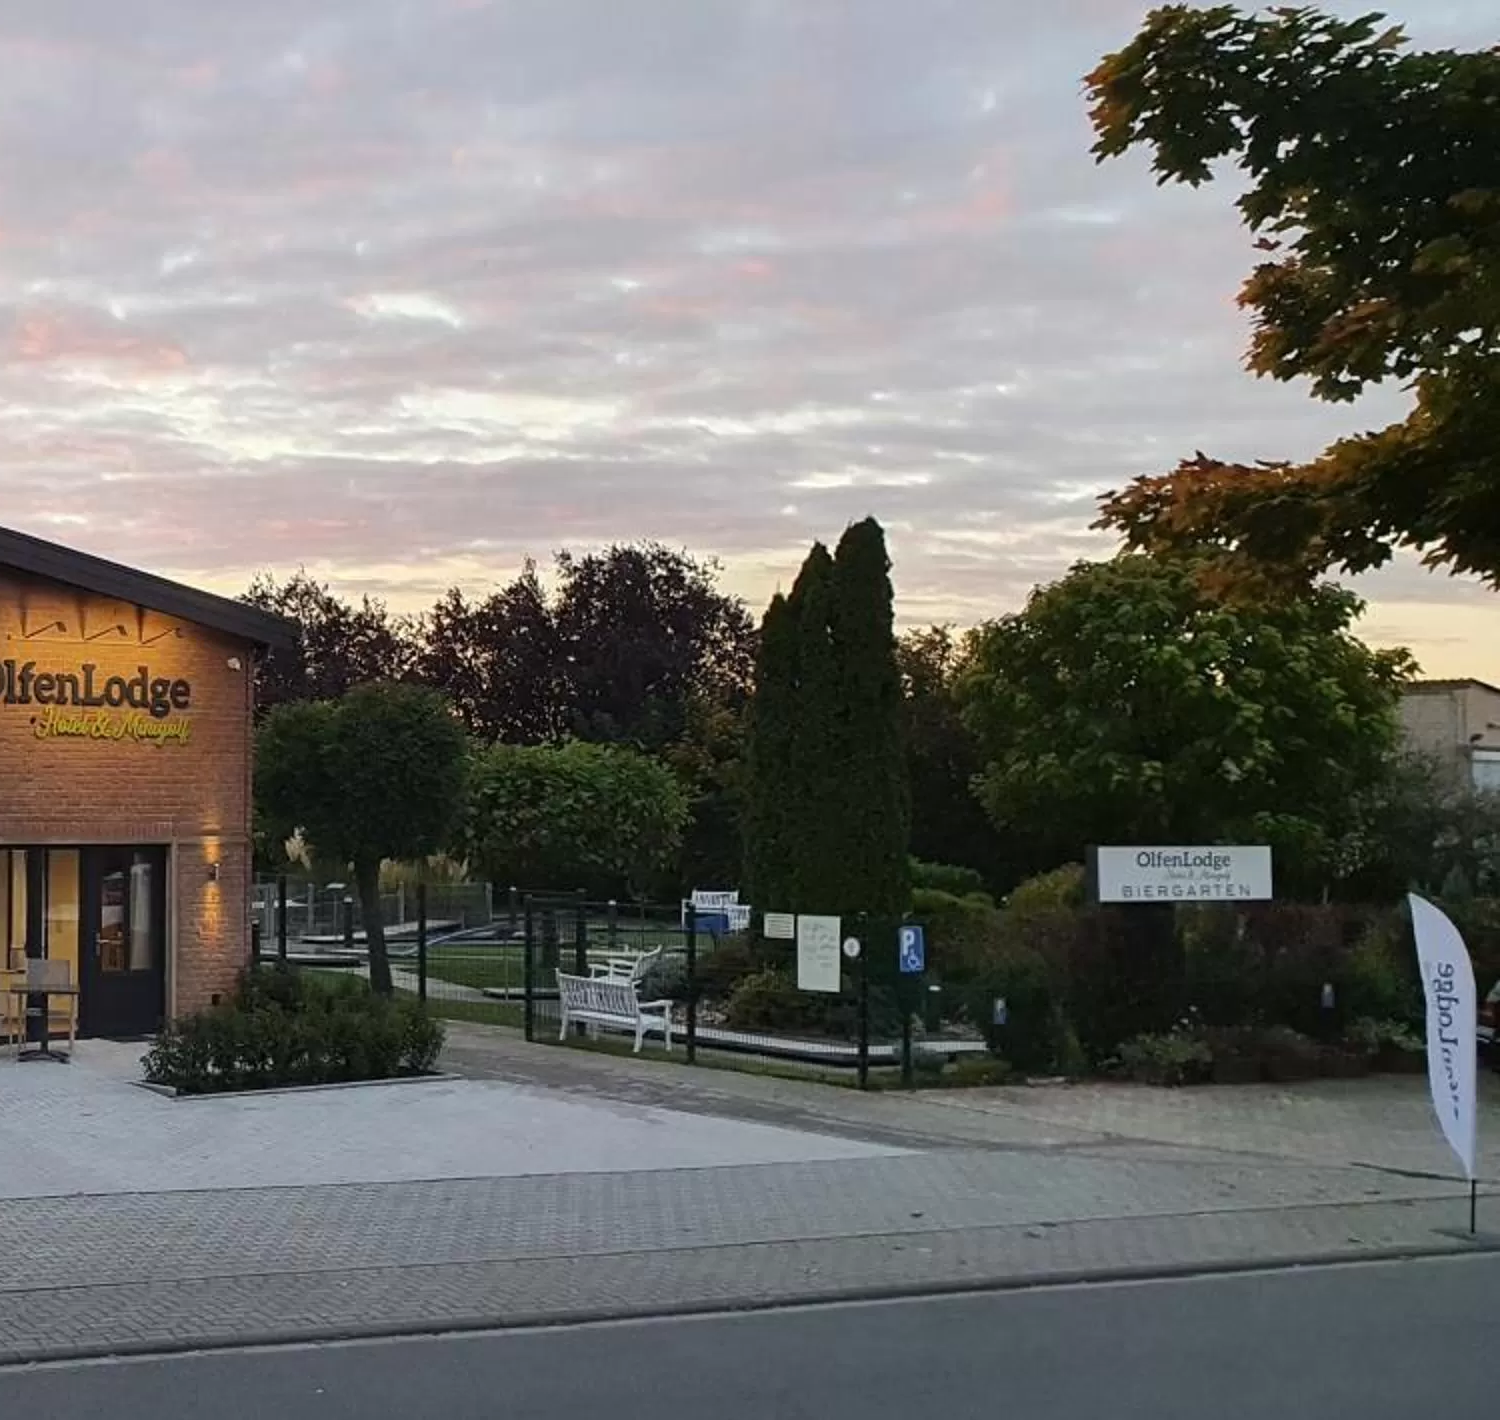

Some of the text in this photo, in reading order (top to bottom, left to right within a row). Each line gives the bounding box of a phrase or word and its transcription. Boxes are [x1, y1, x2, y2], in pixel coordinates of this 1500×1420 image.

[34, 704, 90, 739] Hotel
[1136, 851, 1232, 870] OlfenLodge
[1121, 883, 1252, 898] BIERGARTEN
[902, 929, 915, 956] P
